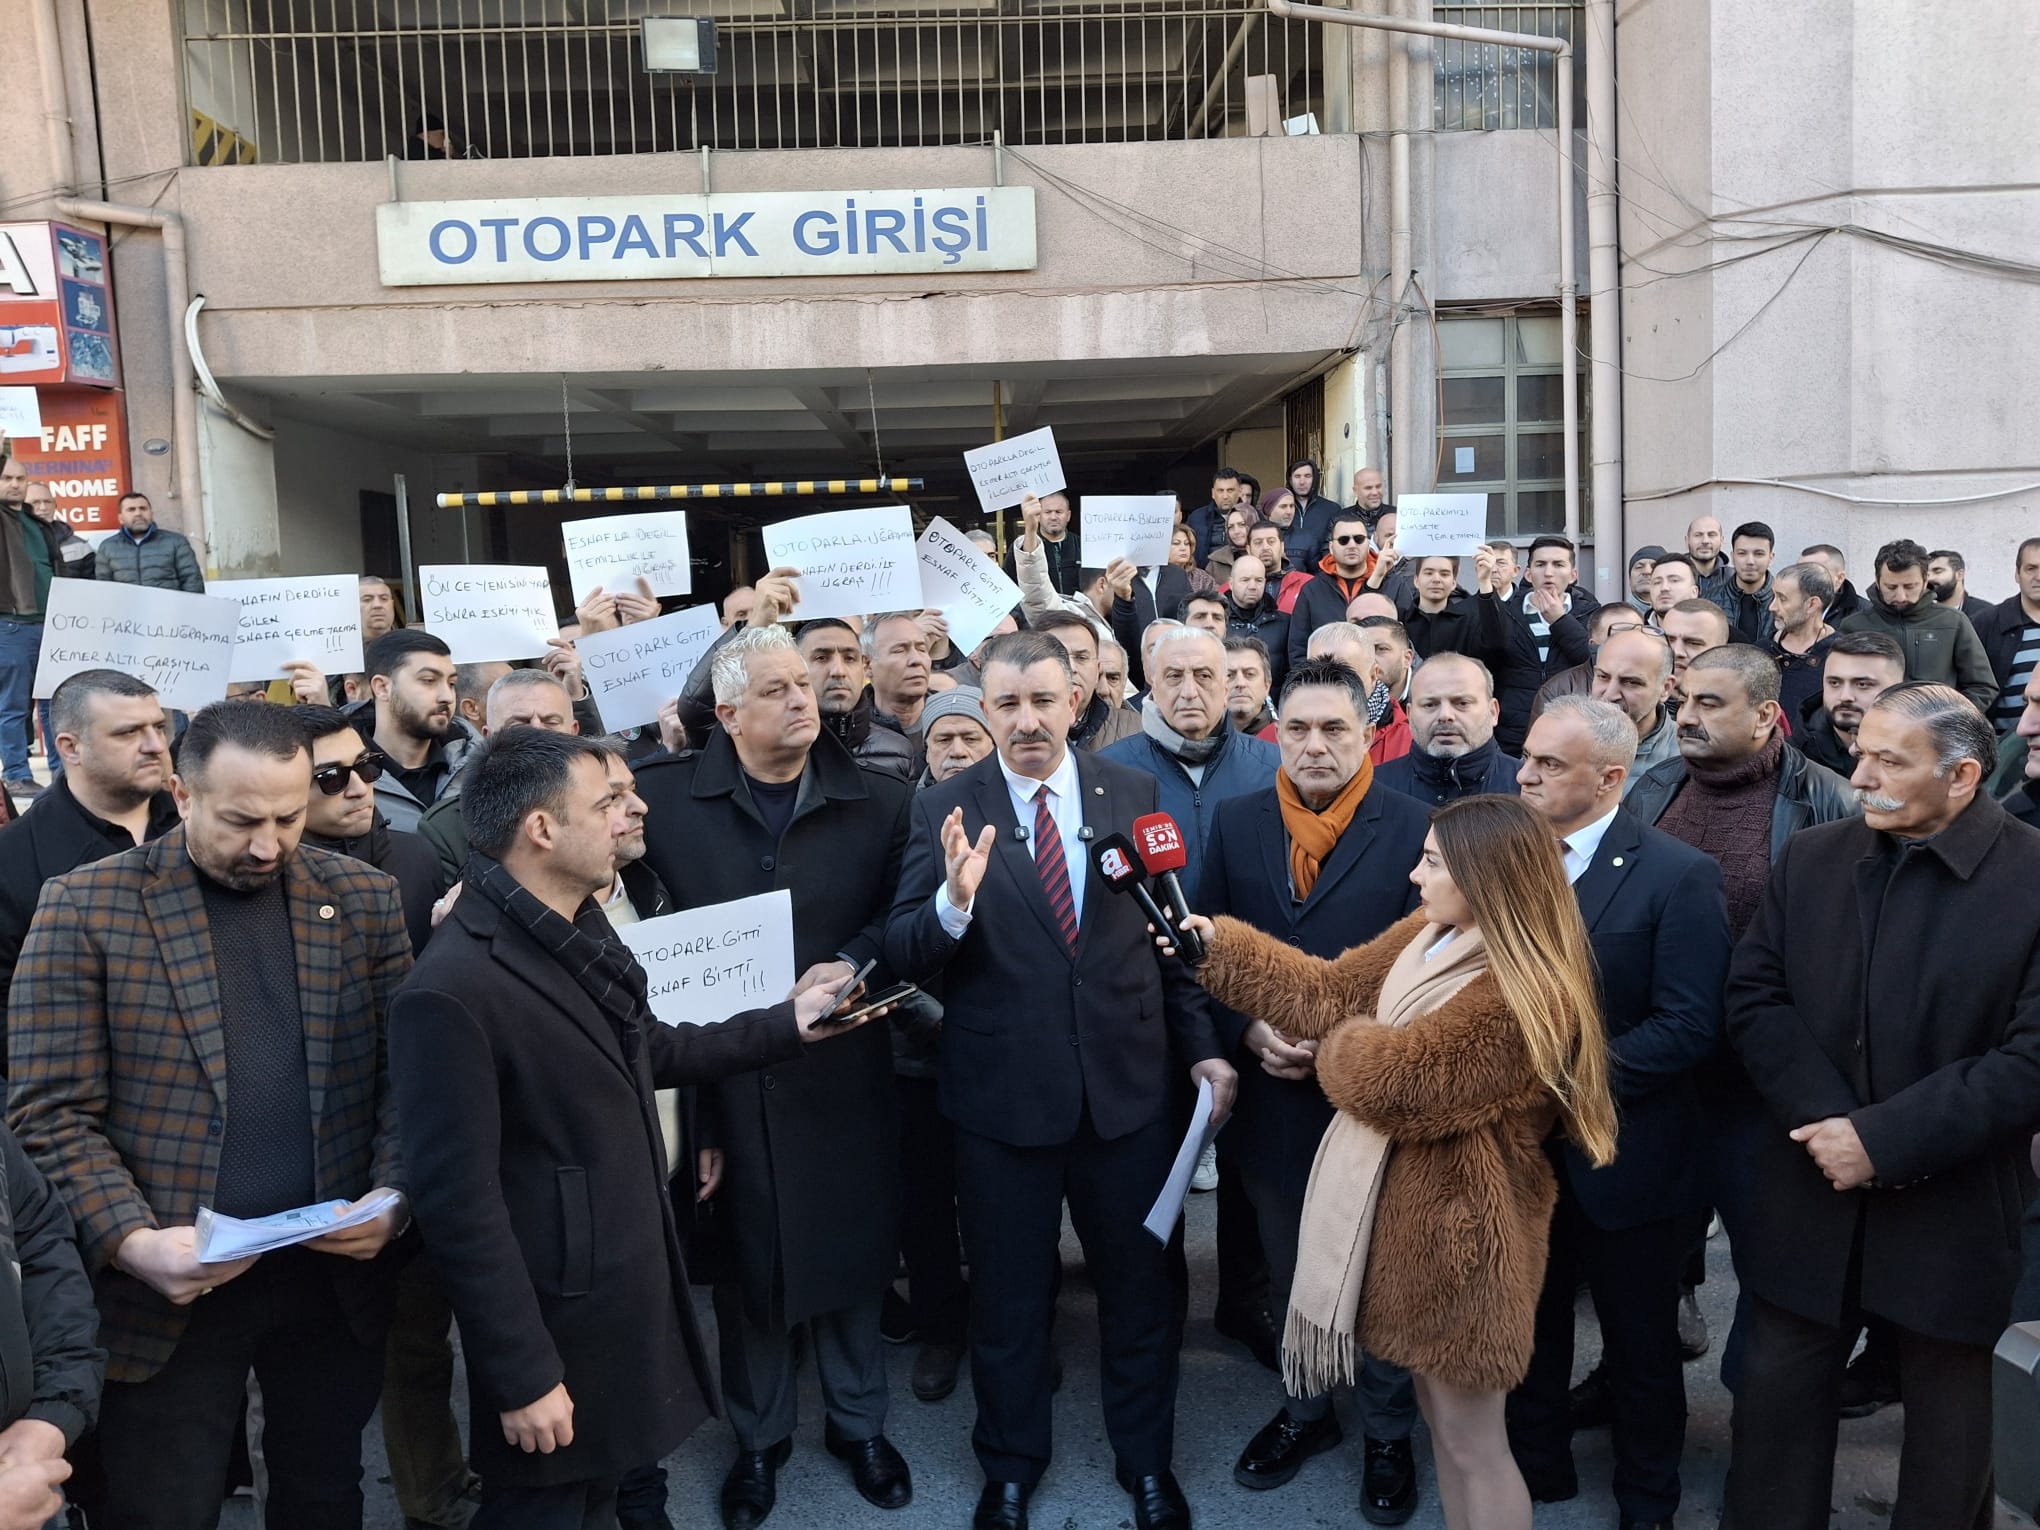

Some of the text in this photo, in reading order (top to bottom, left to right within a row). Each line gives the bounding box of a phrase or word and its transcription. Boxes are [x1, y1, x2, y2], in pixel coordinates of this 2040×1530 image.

[428, 195, 989, 266] OTOPARK GİRİŞİ
[41, 424, 108, 452] FAFF
[48, 478, 118, 498] NOME
[53, 506, 101, 522] NGE
[241, 591, 281, 607] NAFIN
[238, 614, 280, 628] GİLEN
[235, 631, 280, 645] SNAFA
[648, 975, 692, 1001] SNAF
[742, 969, 768, 998] !!!
